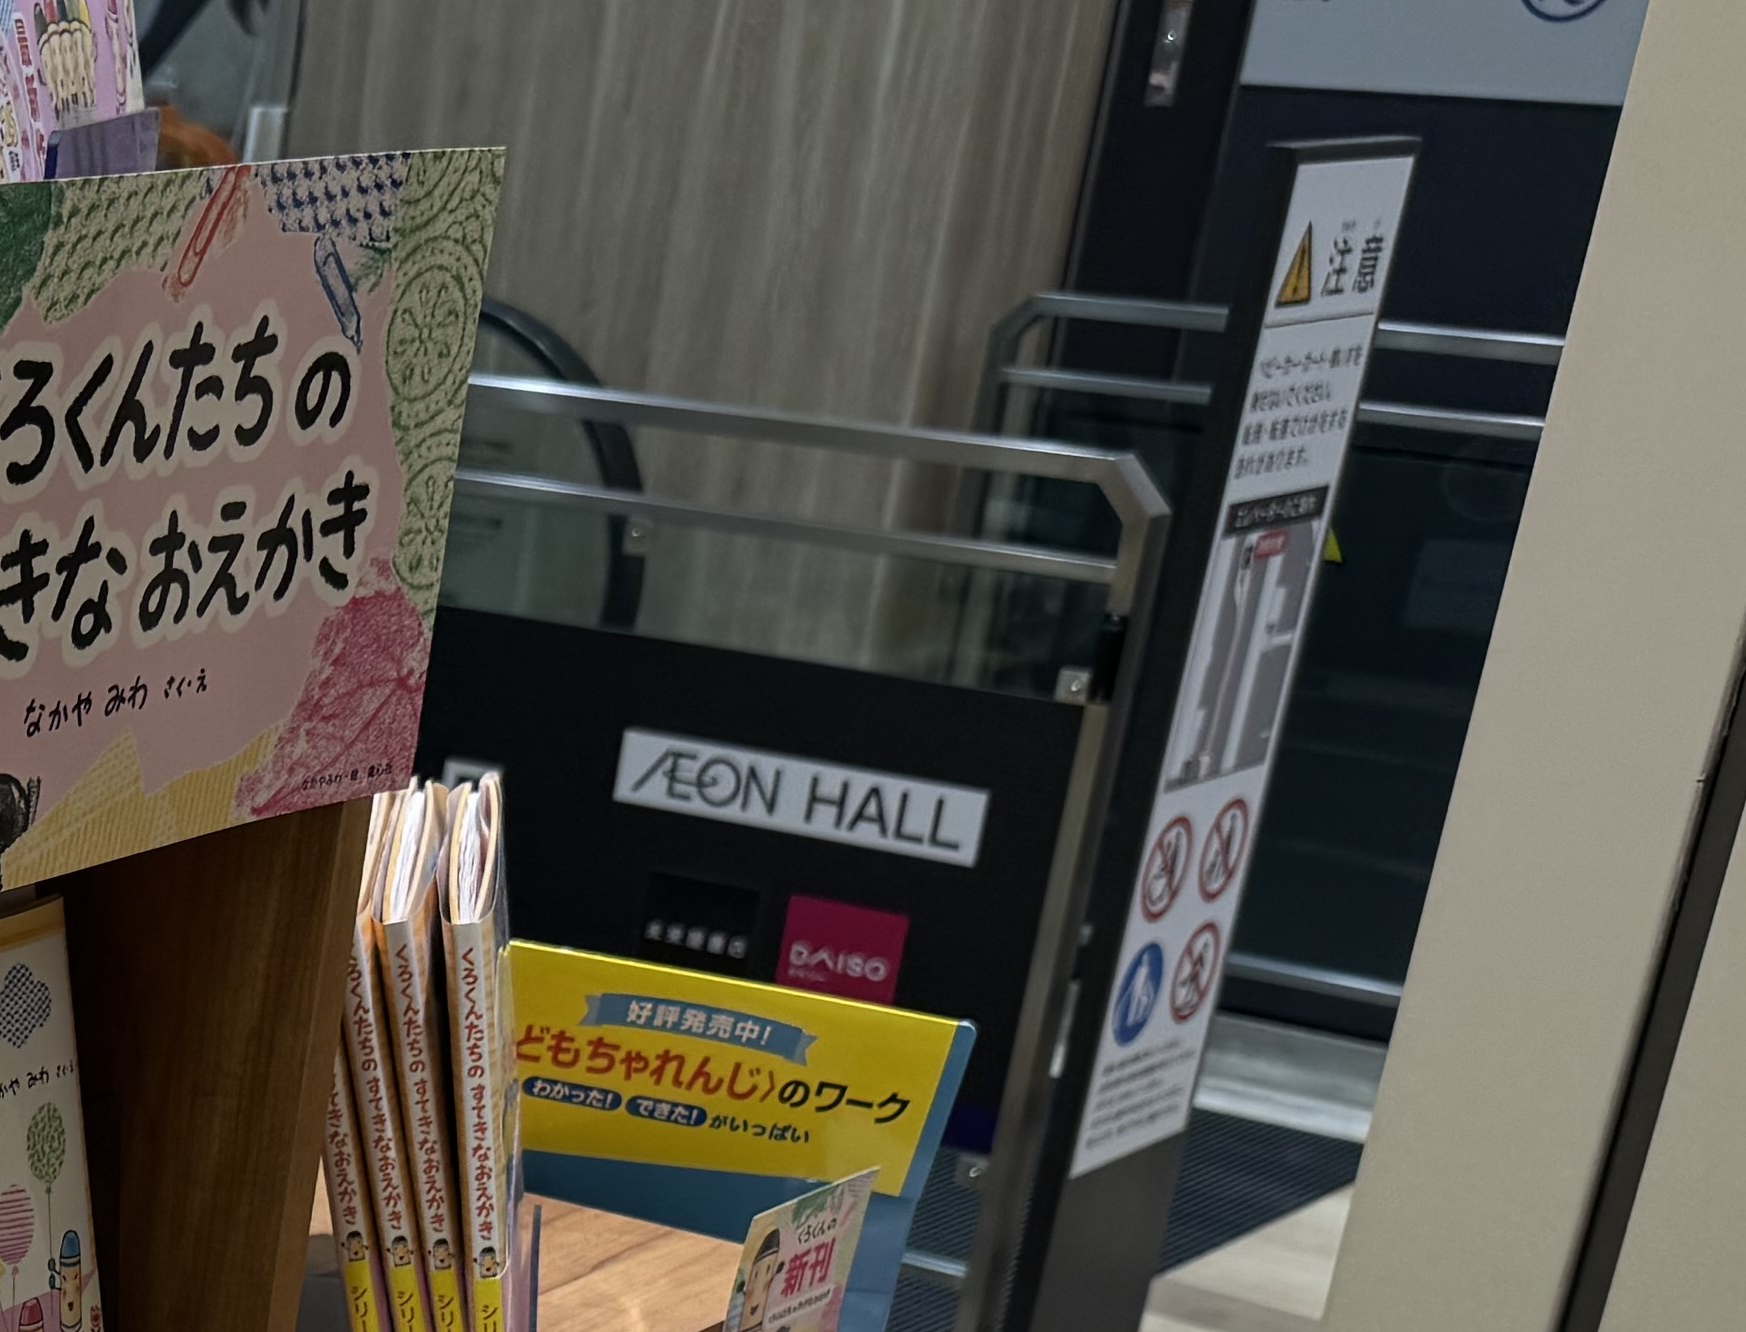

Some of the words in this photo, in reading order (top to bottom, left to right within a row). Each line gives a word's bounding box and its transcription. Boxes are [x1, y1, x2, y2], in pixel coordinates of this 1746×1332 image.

[1321, 234, 1385, 298] 注意
[804, 775, 961, 851] HALL
[626, 1001, 772, 1045] 好評発売中!
[533, 1079, 614, 1110] わかった!
[635, 1099, 699, 1126] できた!
[710, 1114, 811, 1144] がいっぱい
[468, 1083, 495, 1241] すてきなおえかき
[782, 1238, 836, 1297] 新刊
